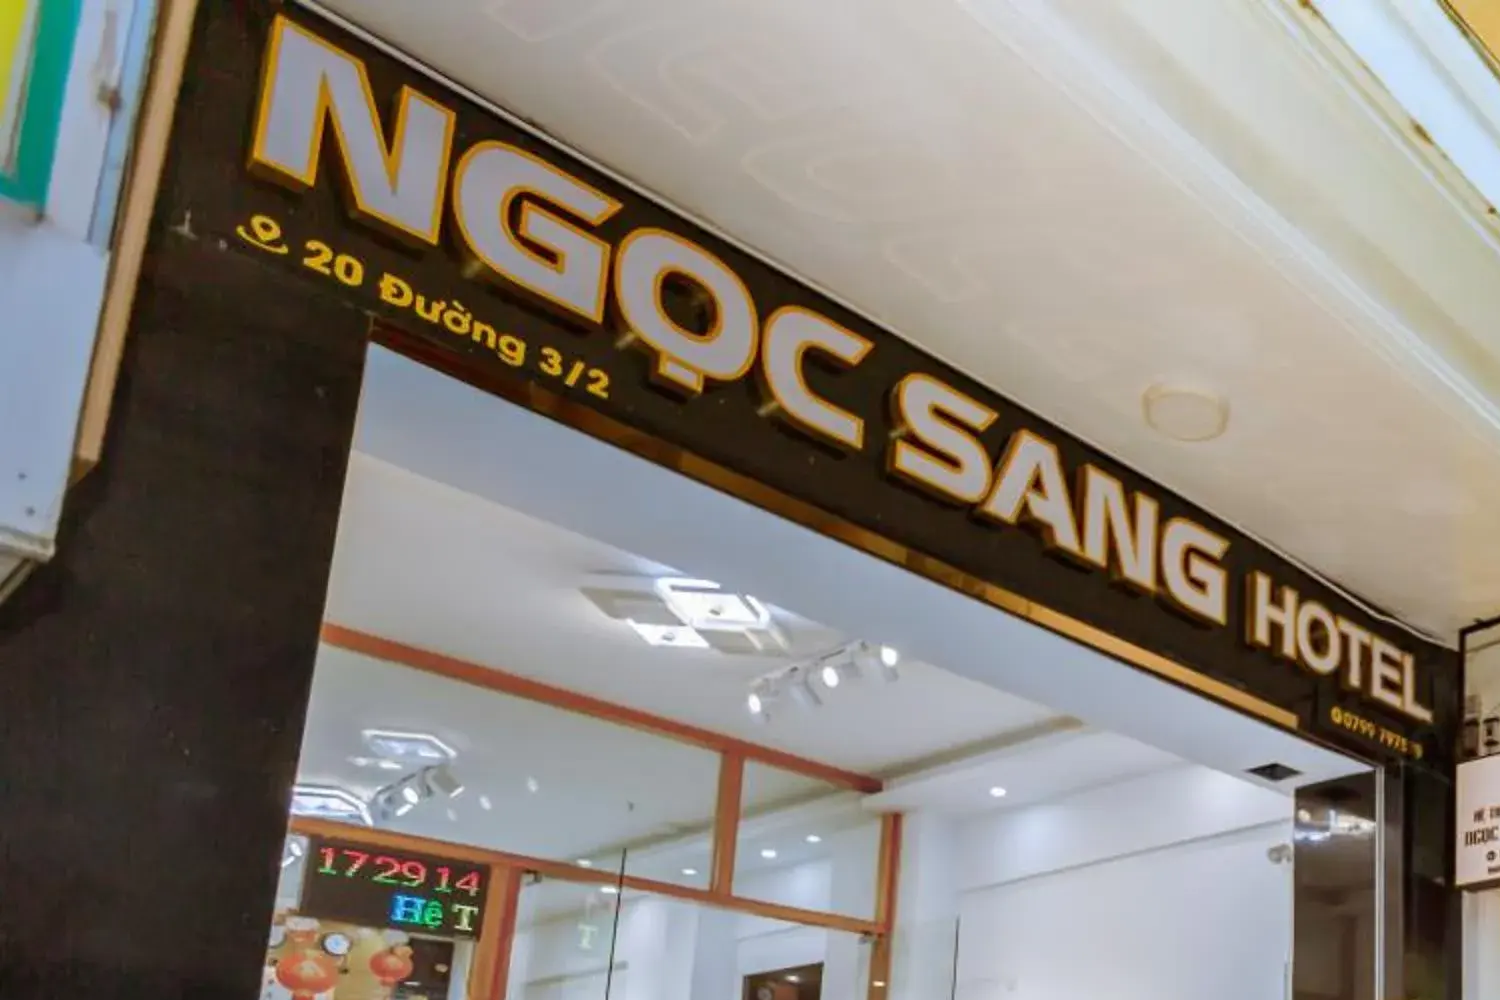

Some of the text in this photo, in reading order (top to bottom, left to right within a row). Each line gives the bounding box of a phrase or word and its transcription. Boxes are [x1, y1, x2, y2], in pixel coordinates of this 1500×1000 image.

[247, 13, 874, 450] NGỌC
[889, 371, 1230, 627] SANG
[1247, 566, 1433, 722] HOTEL
[303, 241, 610, 398] 20 Đường 3/2
